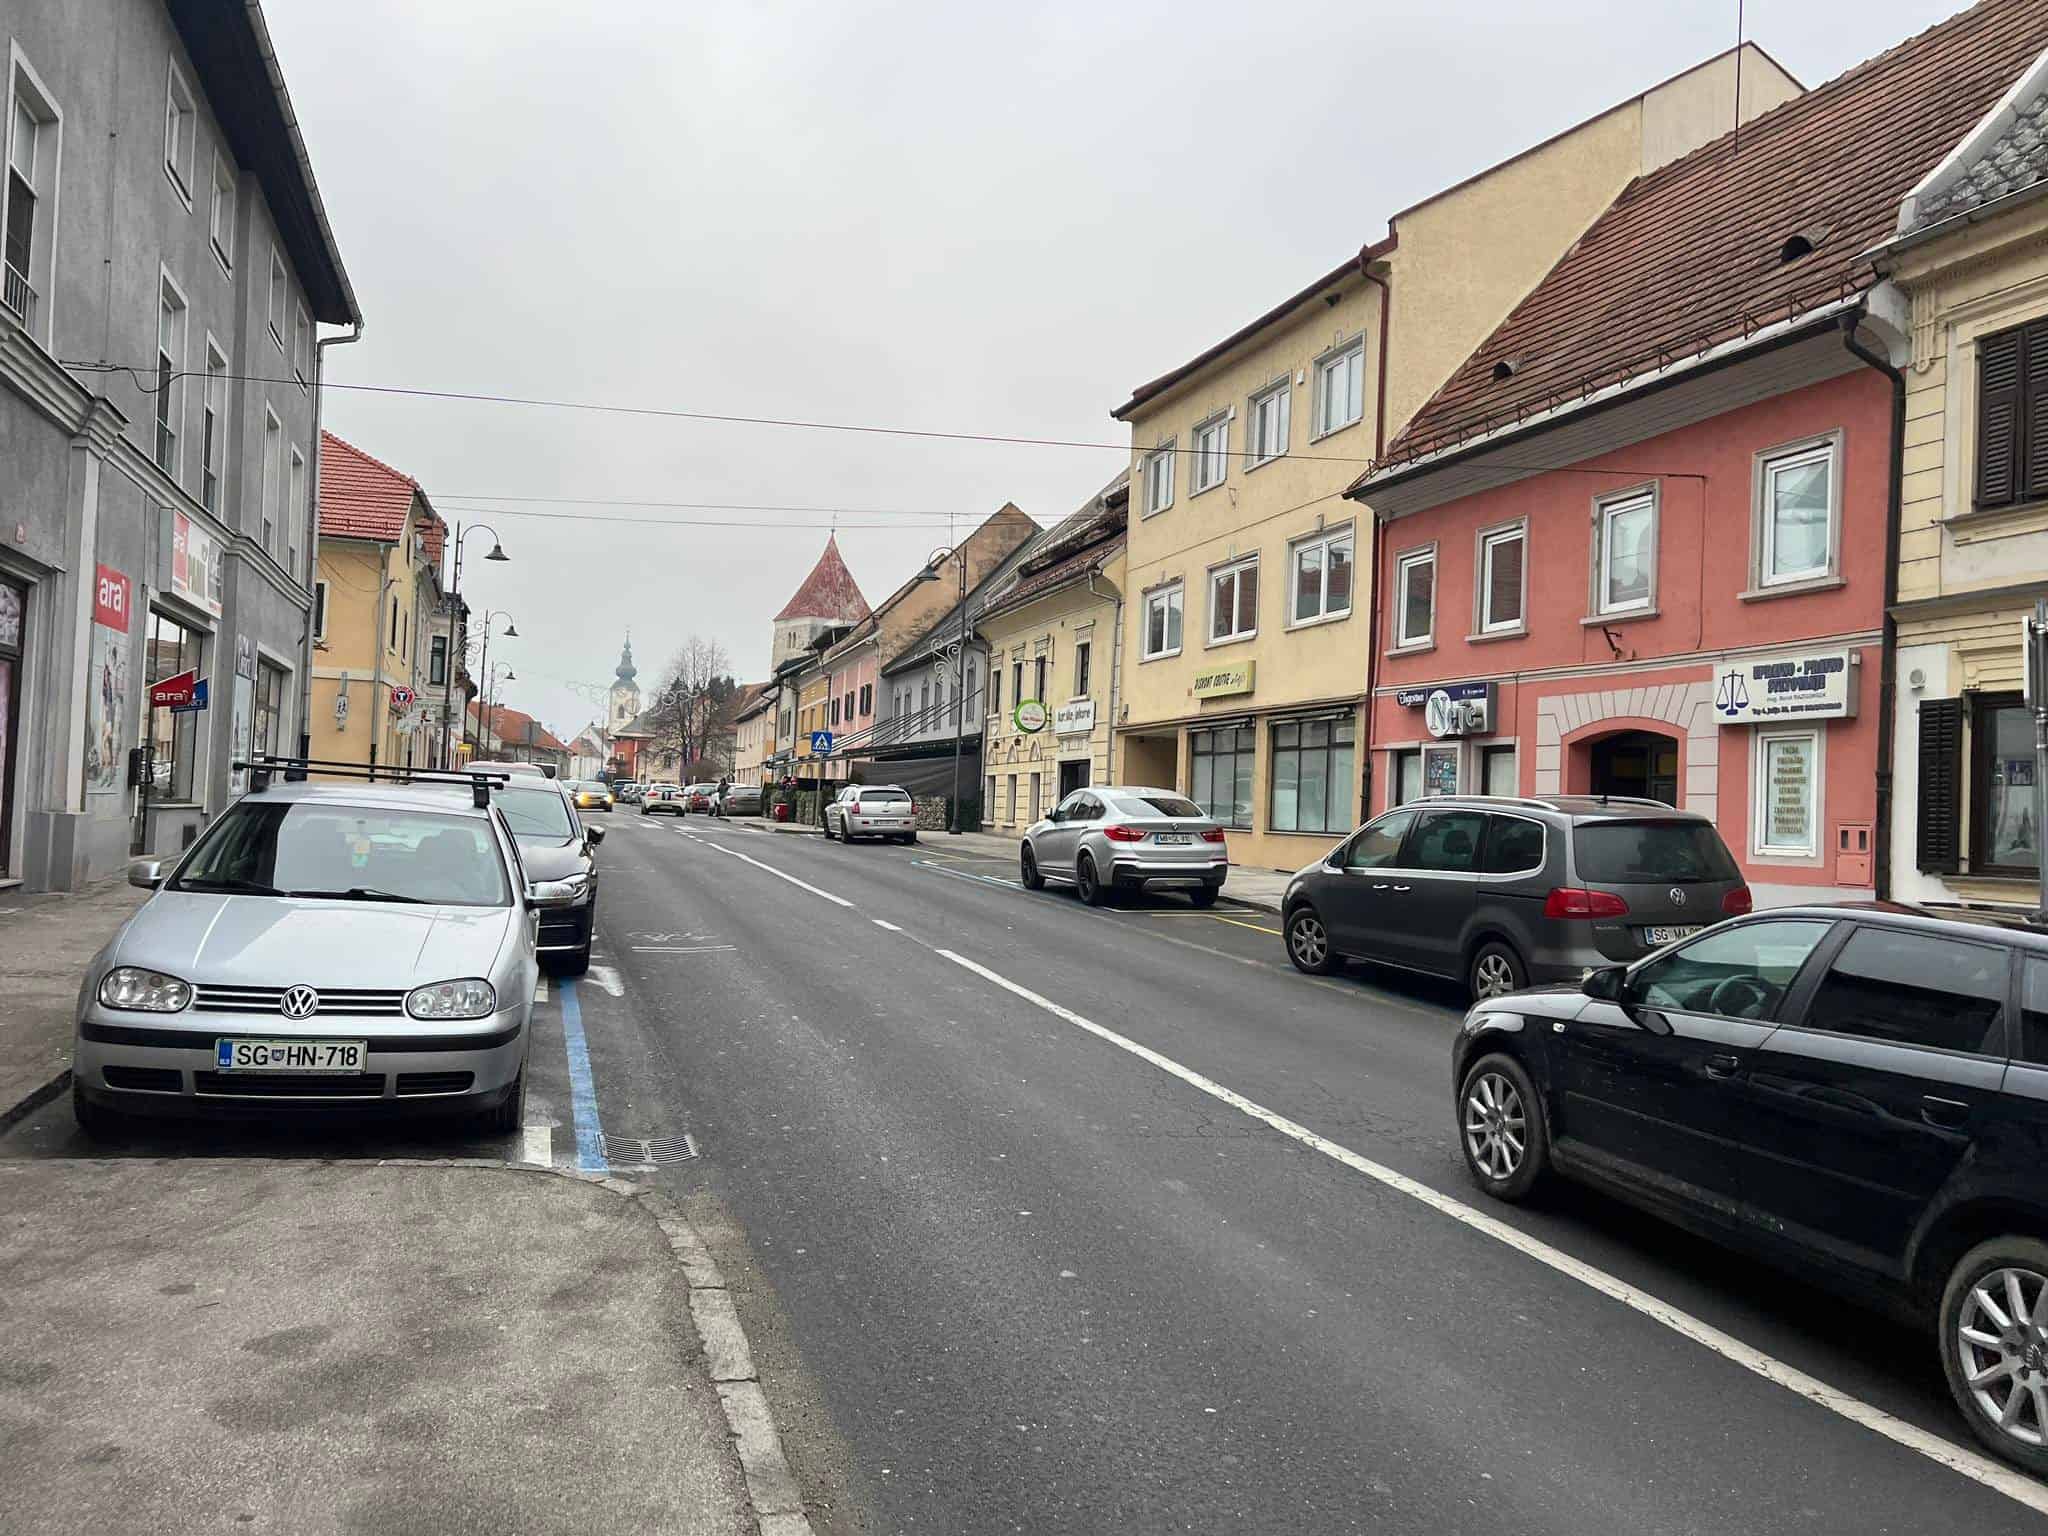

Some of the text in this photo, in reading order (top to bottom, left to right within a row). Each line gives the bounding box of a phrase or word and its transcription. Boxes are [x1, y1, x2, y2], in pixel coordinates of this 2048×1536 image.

[99, 577, 122, 613] ara
[155, 691, 185, 701] ara
[1654, 928, 1668, 941] SG
[237, 1045, 358, 1067] SG HN-718
